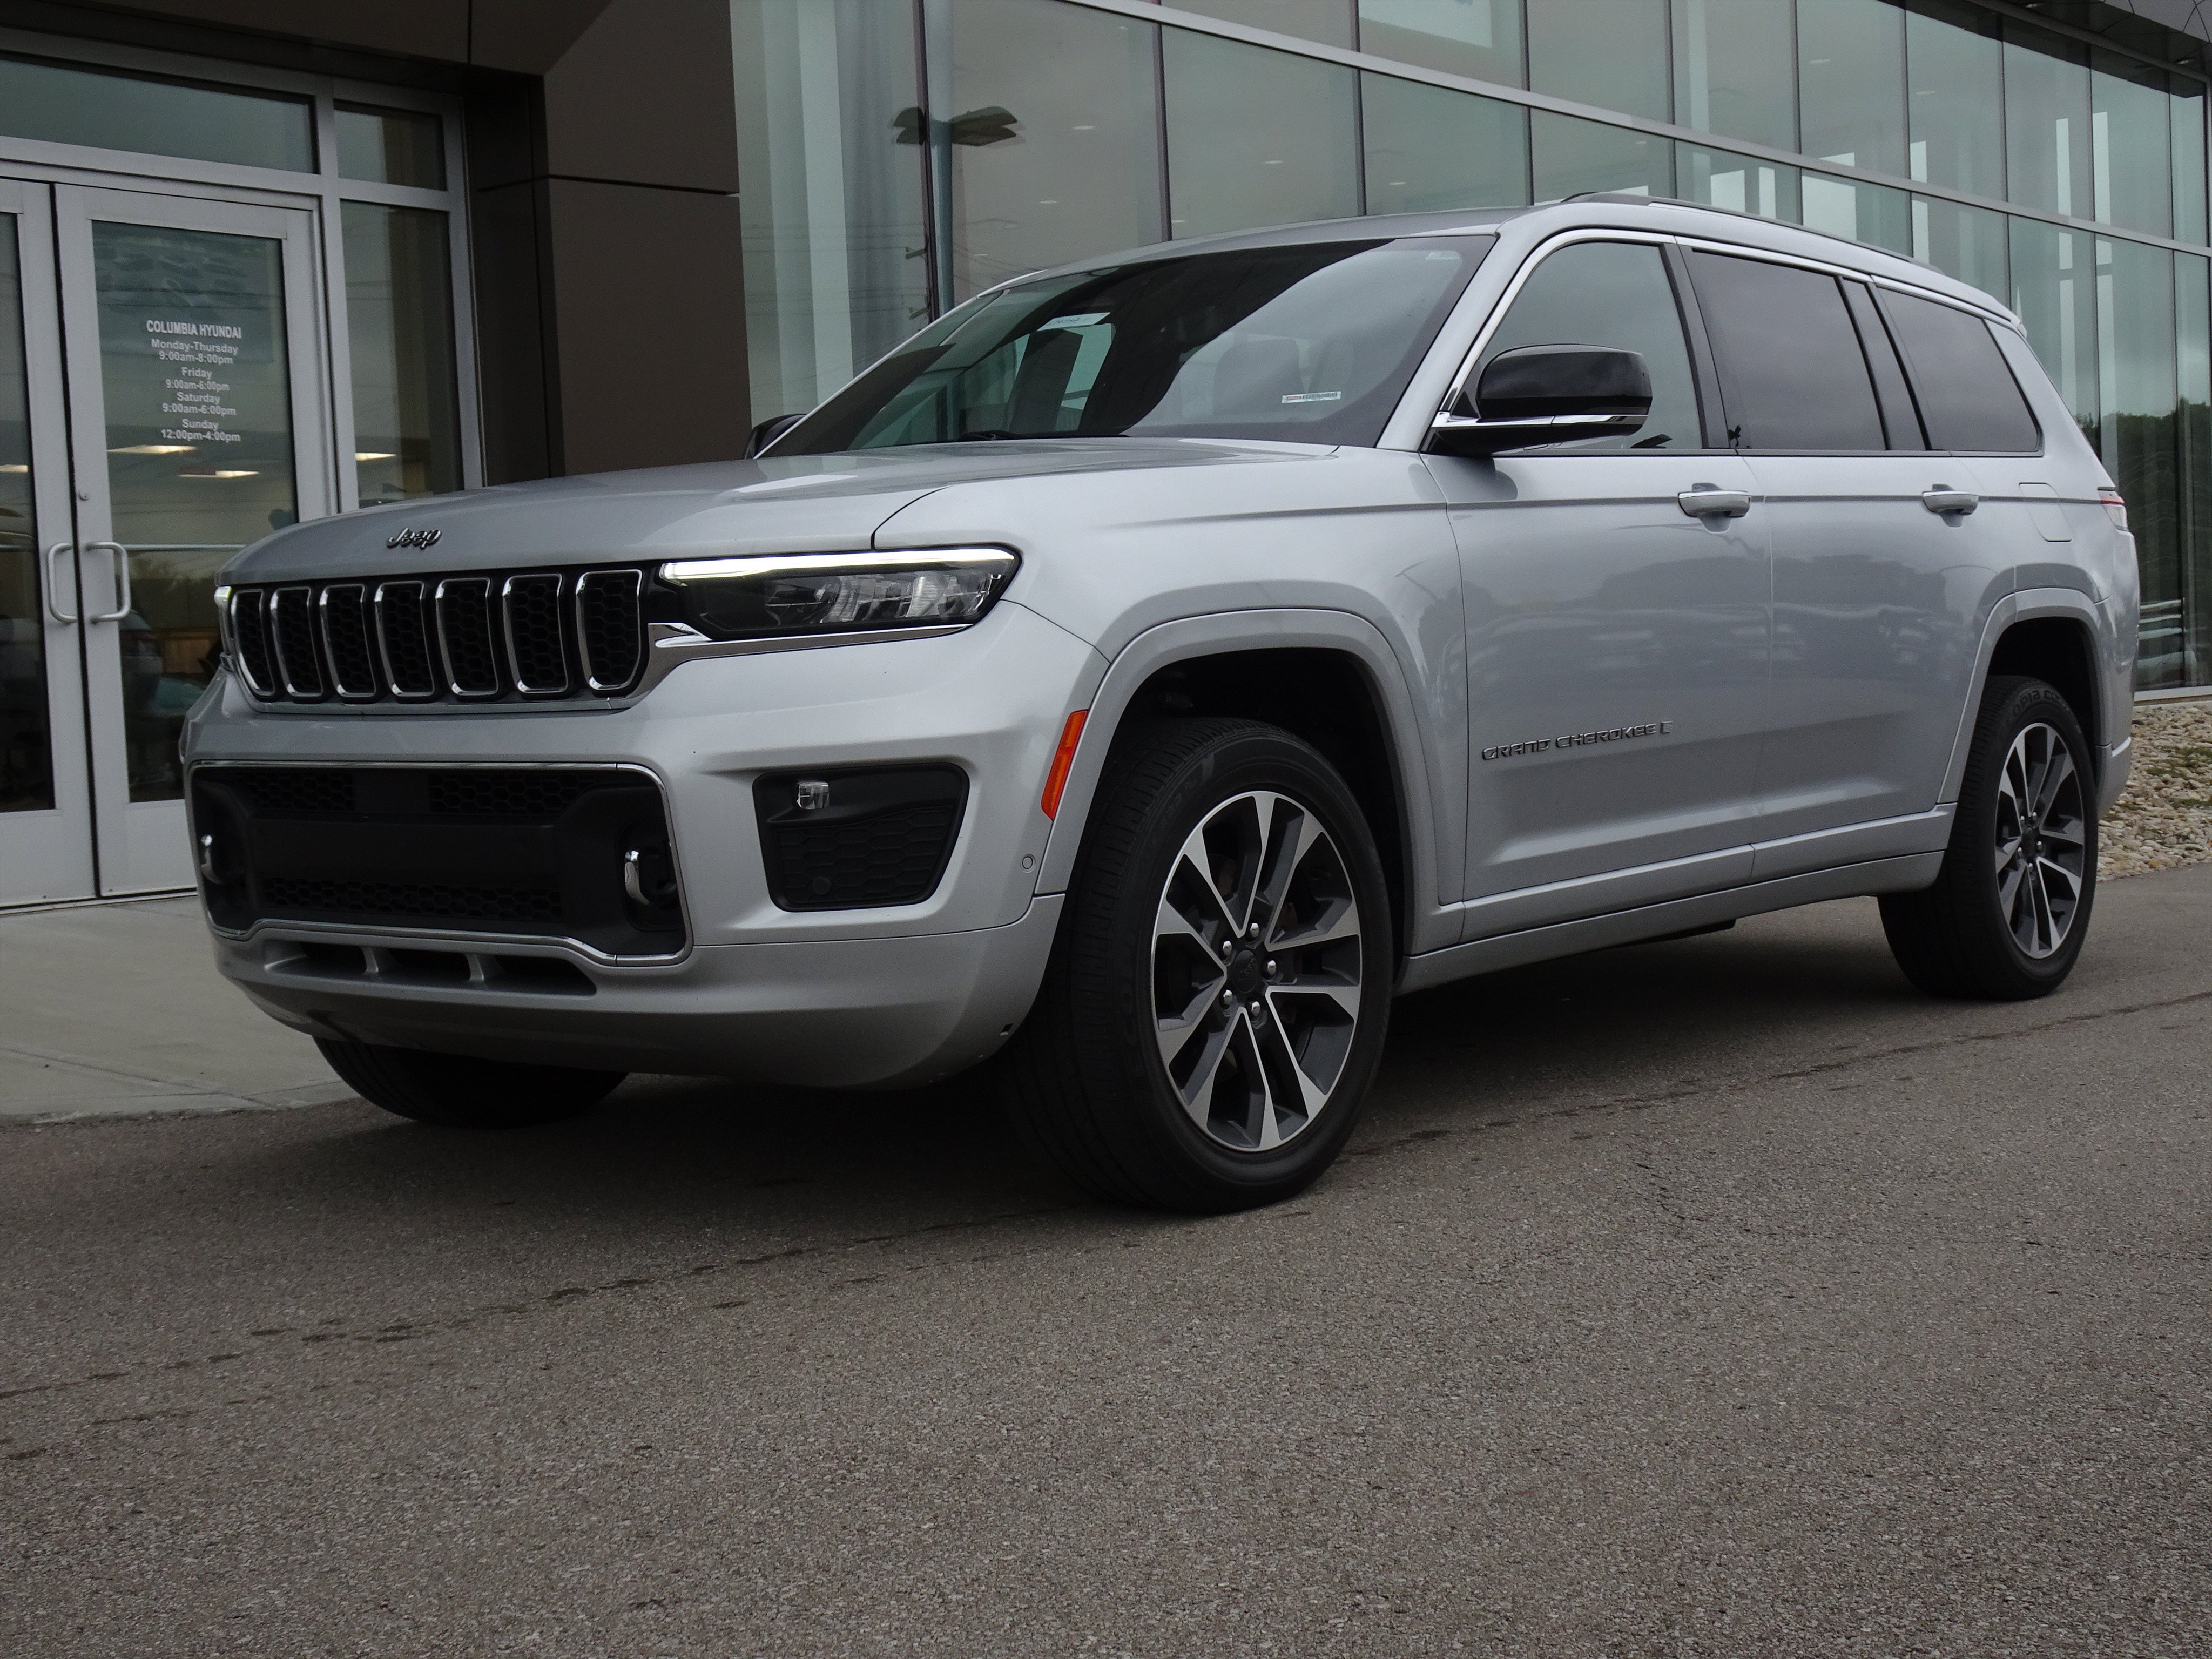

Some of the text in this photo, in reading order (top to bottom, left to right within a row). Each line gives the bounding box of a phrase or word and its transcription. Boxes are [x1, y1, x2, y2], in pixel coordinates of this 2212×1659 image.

[146, 320, 242, 339] COLUMBIA HYUNDAI
[151, 338, 239, 356] Monday-Thursday
[159, 350, 233, 366] 9:00am-8:00pm
[181, 366, 213, 380] Friday
[165, 379, 230, 393] 9:00am-6:00pm
[177, 392, 220, 406] Saturday
[162, 403, 236, 417] 9:00am-6:00pm
[181, 418, 219, 431] Sunday
[161, 428, 241, 444] 12:00pm-4:00pm
[386, 527, 442, 550] Jeep
[1482, 738, 1552, 760] GRAND
[1555, 722, 1658, 748] CHEROKEE
